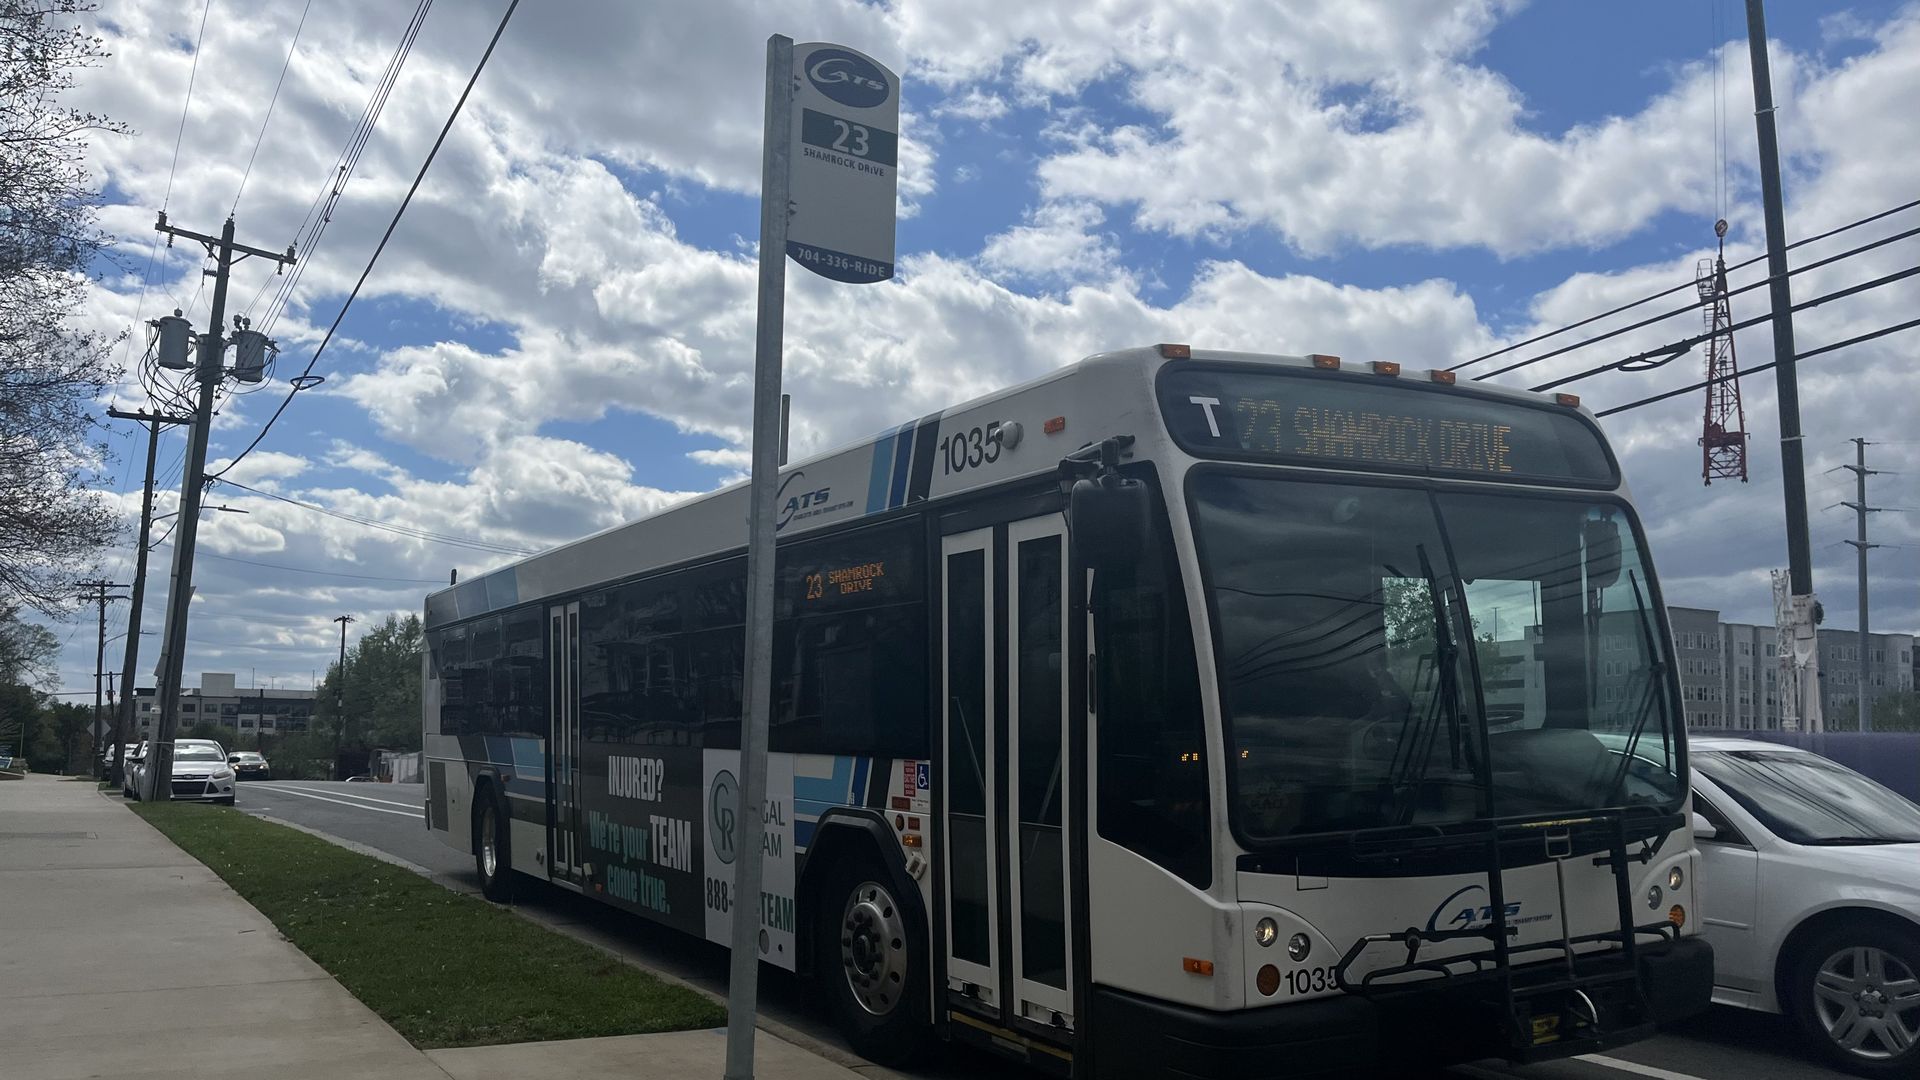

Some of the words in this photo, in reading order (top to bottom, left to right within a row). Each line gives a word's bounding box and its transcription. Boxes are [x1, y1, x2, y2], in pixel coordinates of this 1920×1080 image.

[810, 58, 884, 91] CATS
[803, 147, 855, 169] SHAMROCK
[832, 120, 869, 157] 23
[1189, 396, 1220, 437] T
[940, 421, 1000, 476] 1035
[1295, 406, 1432, 467] SHAMROCK
[1440, 420, 1512, 472] DRIVE
[806, 574, 823, 600] 23
[829, 561, 884, 584] SHAMROCK
[840, 578, 873, 594] DRIVE
[608, 755, 665, 802] INJURED?
[760, 799, 786, 827] GAL
[589, 810, 620, 854] We're
[622, 824, 648, 864] your
[650, 815, 692, 873] TEAM
[607, 863, 639, 903] come
[640, 867, 671, 915] true.
[1285, 966, 1338, 995] 1035
